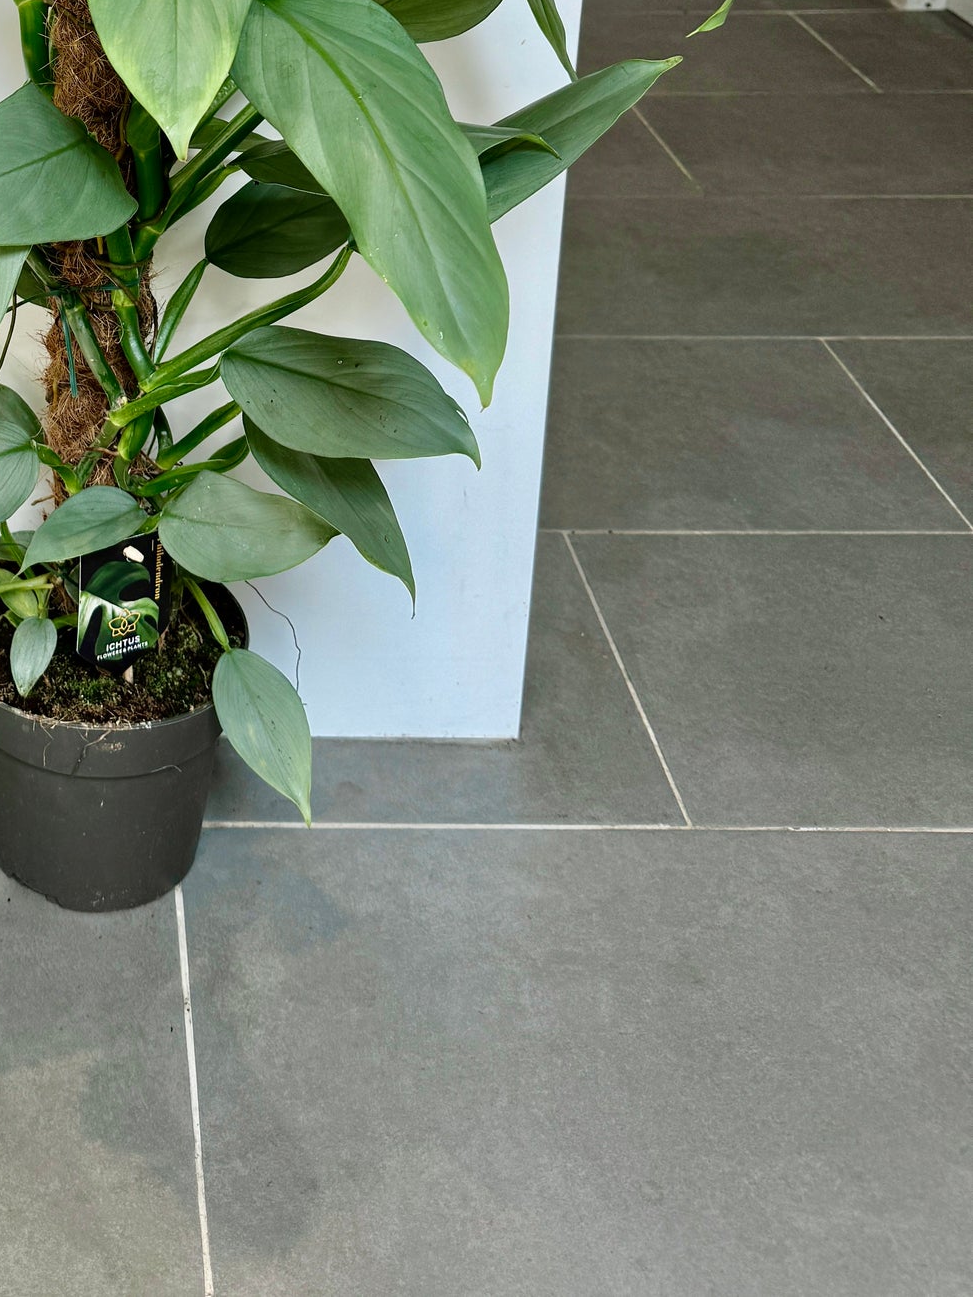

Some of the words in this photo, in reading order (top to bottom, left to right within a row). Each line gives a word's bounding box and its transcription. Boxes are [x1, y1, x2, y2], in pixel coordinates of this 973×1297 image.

[154, 537, 164, 600] hilodendron
[96, 648, 122, 661] FLOWERS
[127, 640, 148, 652] PLANTS
[106, 634, 140, 651] ICHTUS
